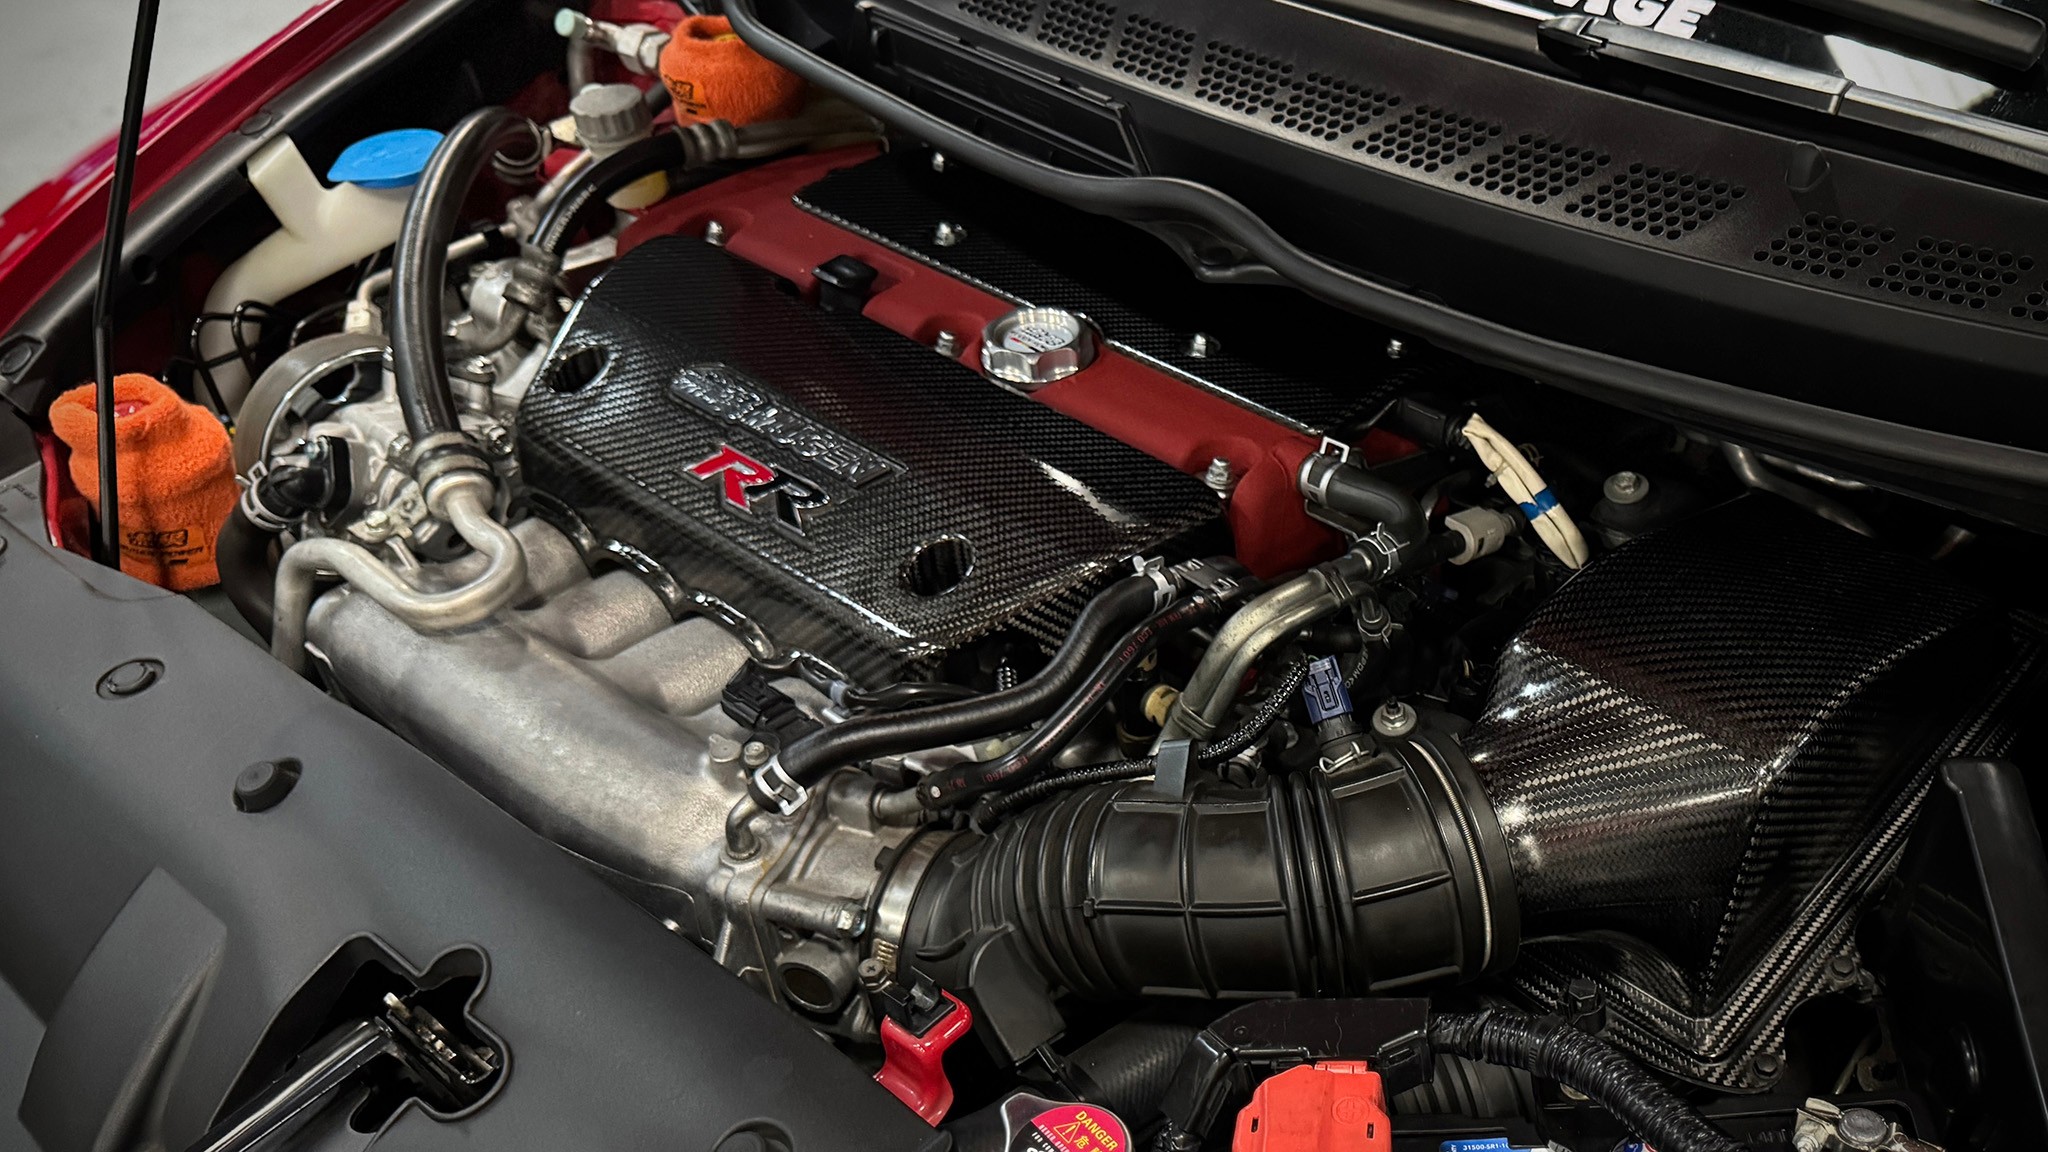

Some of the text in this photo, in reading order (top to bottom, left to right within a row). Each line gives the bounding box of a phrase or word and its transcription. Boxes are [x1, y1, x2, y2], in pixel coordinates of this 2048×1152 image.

[1553, 0, 1717, 39] GE
[683, 442, 832, 537] RR
[1075, 1110, 1118, 1151] DANGER
